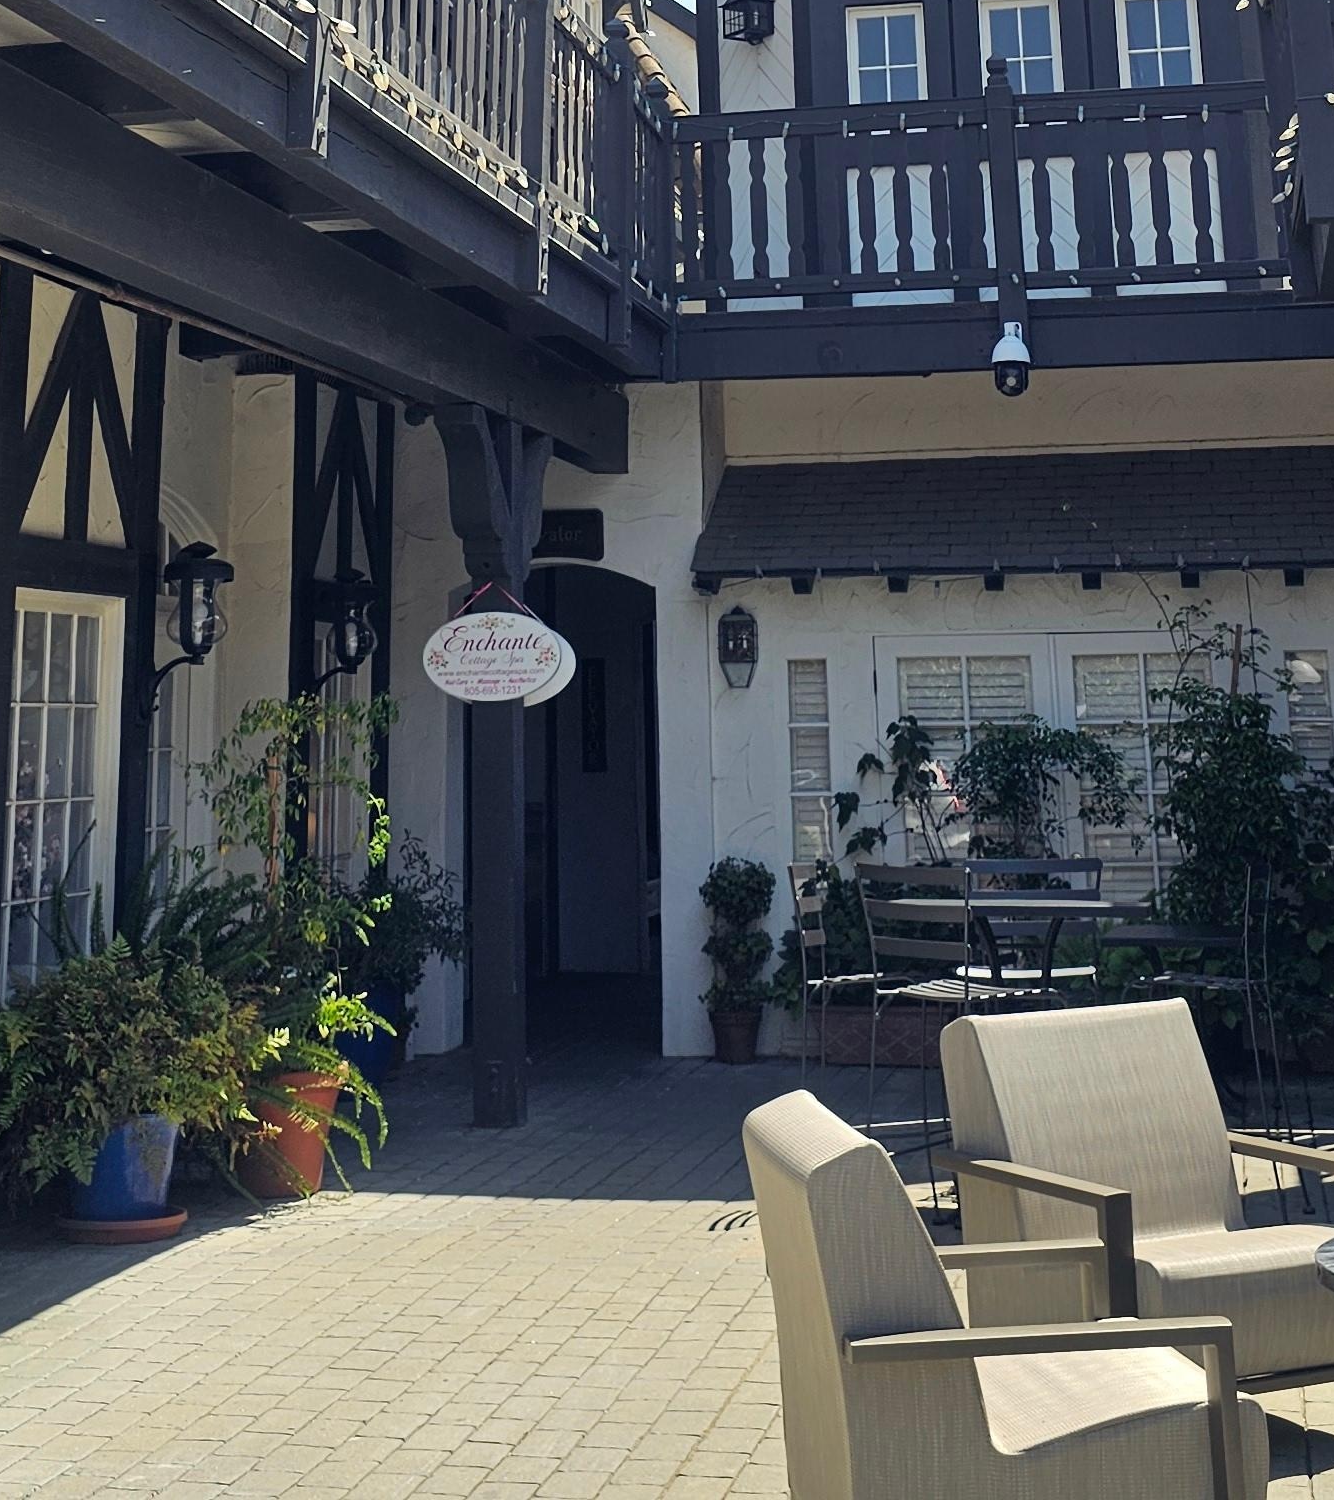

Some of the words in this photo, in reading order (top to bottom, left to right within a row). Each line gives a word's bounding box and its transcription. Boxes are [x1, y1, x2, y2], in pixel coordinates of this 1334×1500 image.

[460, 654, 497, 668] Cottage
[503, 652, 524, 667] Spa
[464, 685, 522, 696] 805-693-1231
